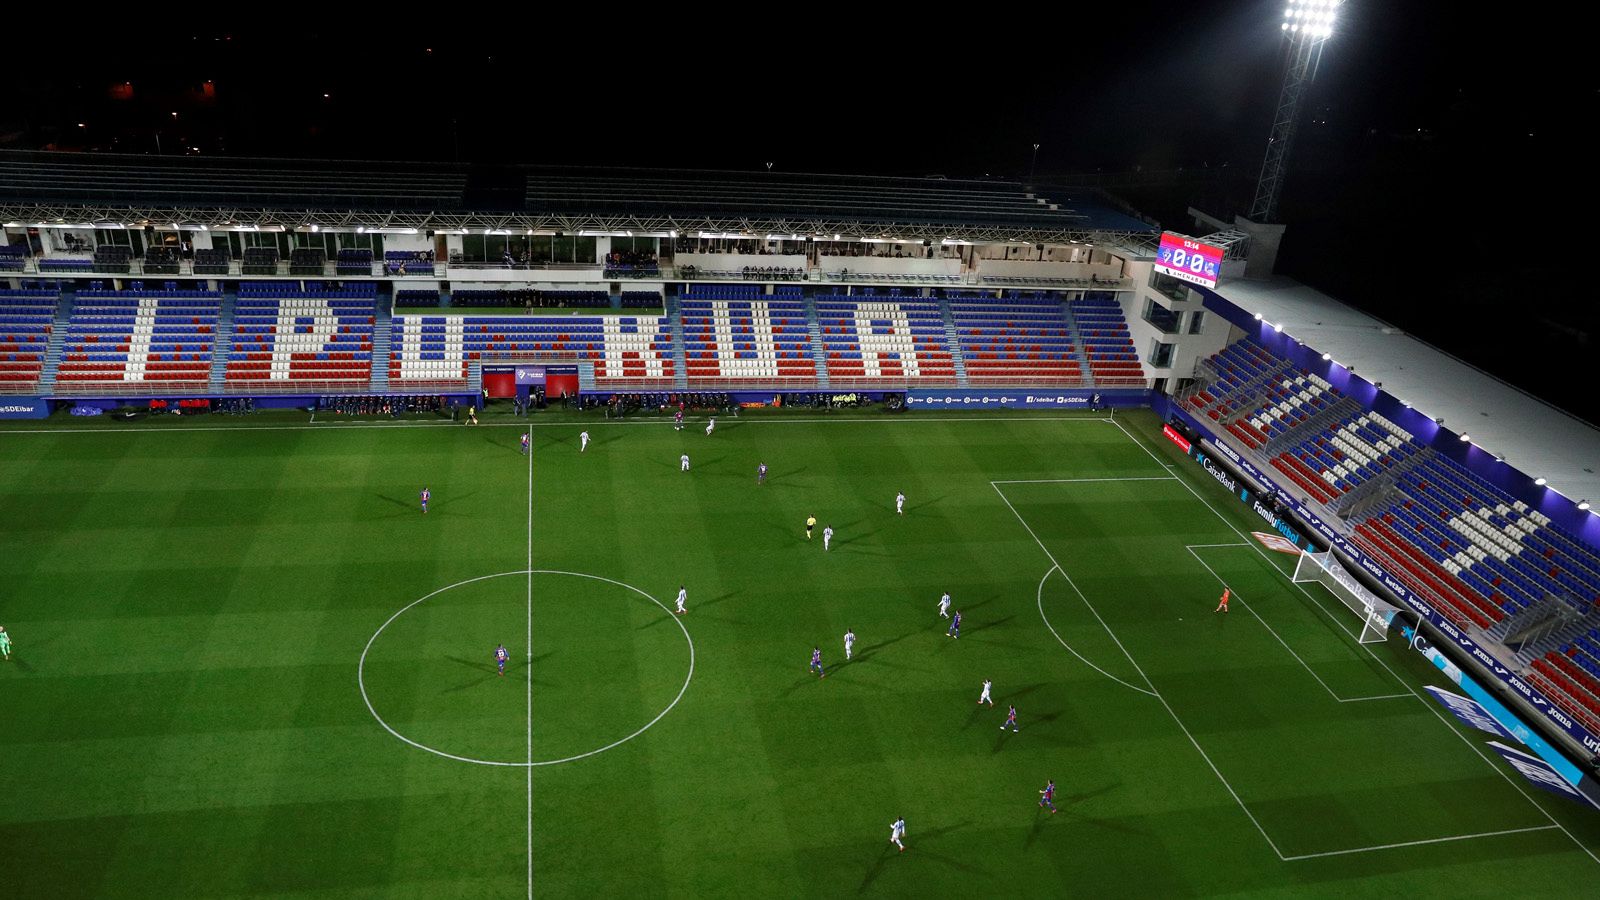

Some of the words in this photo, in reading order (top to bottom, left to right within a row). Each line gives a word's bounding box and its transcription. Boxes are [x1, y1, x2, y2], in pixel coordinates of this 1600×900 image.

[1172, 271, 1208, 285] AMENABAR
[1203, 457, 1236, 493] CaixaBank
[1362, 558, 1383, 577] bet365
[1384, 576, 1406, 596] bet365
[1408, 595, 1431, 616] bet365
